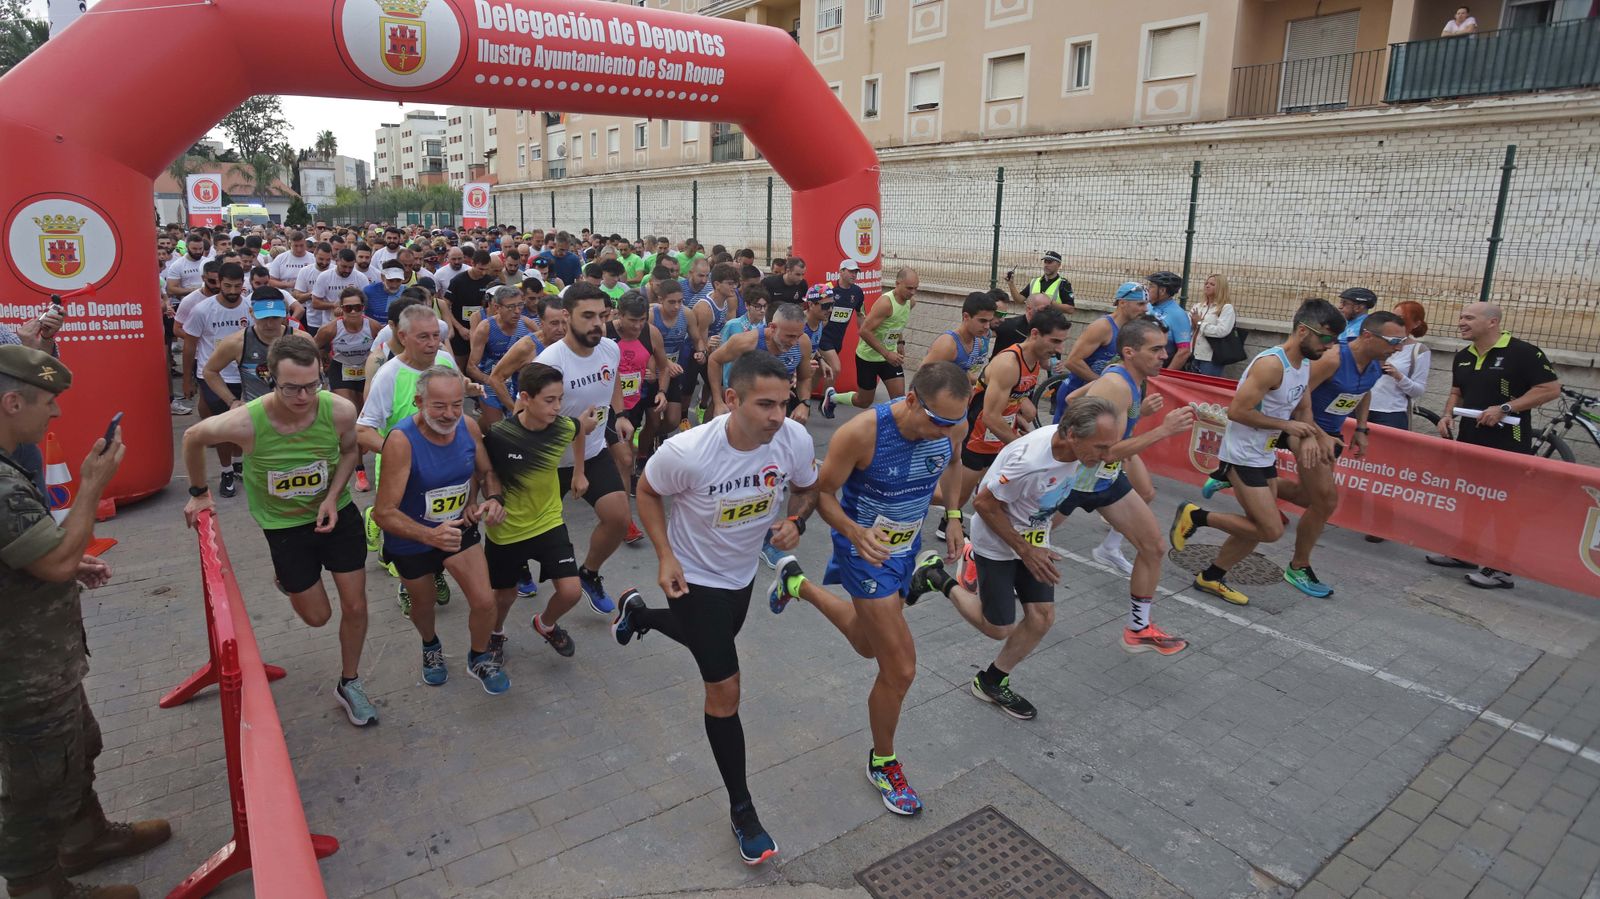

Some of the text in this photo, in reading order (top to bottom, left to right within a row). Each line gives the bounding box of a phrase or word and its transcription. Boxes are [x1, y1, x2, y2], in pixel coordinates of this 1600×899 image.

[475, 0, 726, 58] Delegación de Deportes
[477, 38, 726, 87] Ilustre Ayuntamiento de San Roque
[67, 302, 85, 317] de
[88, 302, 143, 318] Deportes
[89, 321, 101, 331] de
[102, 320, 118, 330] San
[120, 320, 144, 330] Roque
[276, 472, 322, 490] 400
[1399, 467, 1417, 482] de
[1421, 470, 1450, 490] San
[1454, 478, 1508, 502] Roque
[432, 492, 466, 513] 370
[1348, 475, 1368, 492] DE
[1371, 479, 1457, 512] DEPORTES
[723, 499, 769, 520] 128
[882, 529, 914, 545] 09
